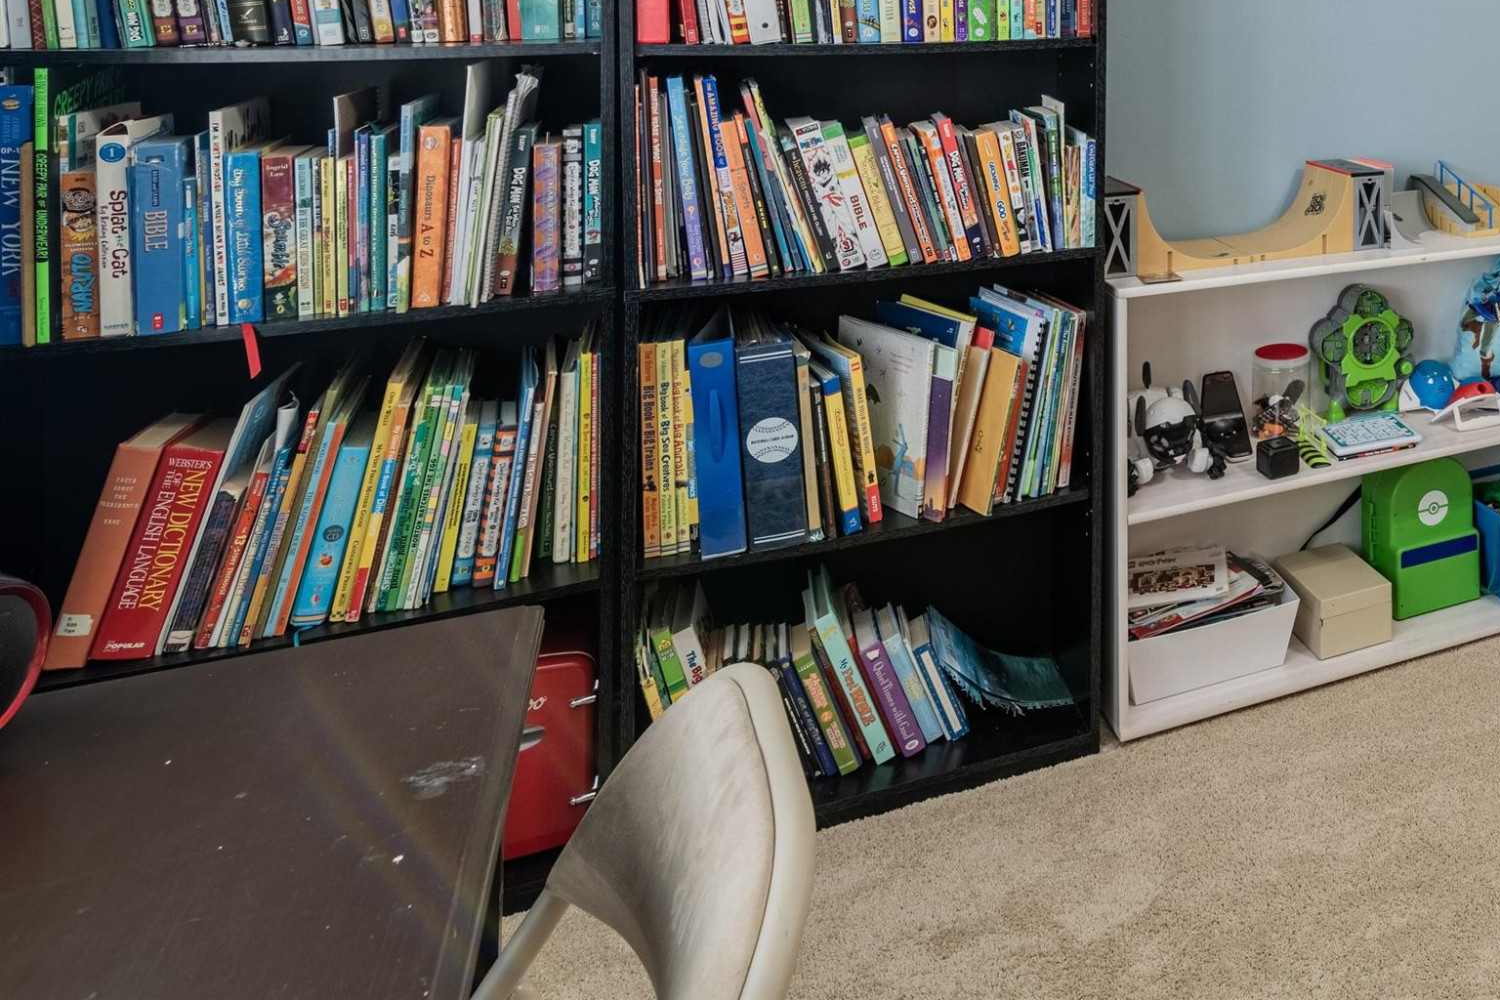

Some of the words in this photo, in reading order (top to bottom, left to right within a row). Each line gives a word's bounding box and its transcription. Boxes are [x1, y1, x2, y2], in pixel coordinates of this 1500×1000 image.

[124, 10, 139, 26] MAN
[885, 6, 894, 20] IVAN
[127, 25, 142, 41] DOG
[649, 88, 658, 114] HORTON
[650, 116, 659, 136] HEARS
[674, 114, 686, 130] See
[652, 143, 660, 162] WHO!
[677, 132, 689, 156] inside
[35, 153, 47, 180] CREEPY
[588, 159, 599, 176] DOG
[679, 156, 692, 177] Your
[948, 150, 961, 167] DOG
[1015, 141, 1029, 177] BAKUMAN
[1, 158, 20, 208] NEW
[510, 166, 525, 185] DOG
[952, 166, 965, 182] MAN
[35, 182, 47, 197] PAIR
[508, 185, 523, 204] MAN
[588, 178, 599, 194] MAN
[681, 177, 695, 200] Body
[988, 160, 1000, 191] GROWING
[996, 200, 1006, 219] GOD
[422, 175, 437, 221] Dinosaurs
[108, 190, 126, 233] Splat
[848, 194, 869, 230] BIBLE
[143, 210, 168, 251] BIBLE
[299, 217, 308, 228] THE
[420, 223, 433, 233] A
[36, 209, 48, 258] UNDERWEAR!
[116, 235, 124, 247] the
[268, 214, 291, 268] Scumble
[299, 230, 308, 248] GREAT
[422, 236, 430, 245] to
[2, 220, 21, 276] YORK
[418, 248, 433, 258] Z
[111, 248, 128, 278] Cat
[300, 250, 309, 266] HORN
[69, 253, 95, 312] NARUTO
[300, 268, 309, 289] SPOON!
[642, 385, 654, 398] Big
[658, 382, 669, 394] Big
[671, 382, 681, 394] Big
[643, 401, 654, 421] Book
[659, 396, 669, 411] book
[672, 396, 681, 415] book
[643, 430, 654, 445] Big
[659, 421, 670, 435] Big
[673, 423, 683, 437] Big
[662, 437, 670, 452] Sea
[751, 438, 769, 446] BASEBALL
[168, 457, 213, 470] WEBSTER'S
[644, 446, 655, 471] Trains
[674, 440, 685, 476] Animals
[161, 470, 175, 489] THE
[172, 472, 183, 487] OF
[661, 454, 672, 491] Creatures
[182, 469, 208, 509] NEW
[411, 520, 422, 548] HORTON
[418, 489, 429, 518] HATCHES
[428, 457, 436, 471] EGG
[143, 490, 176, 542] ENGLISH
[138, 509, 196, 612] DICTIONARY
[118, 544, 158, 610] LANGUAGE
[105, 642, 145, 650] POPULAR
[685, 650, 698, 669] The
[691, 665, 704, 685] Big
[870, 661, 889, 686] Quiet
[880, 682, 898, 707] Times
[890, 705, 905, 724] with
[897, 721, 913, 740] God
